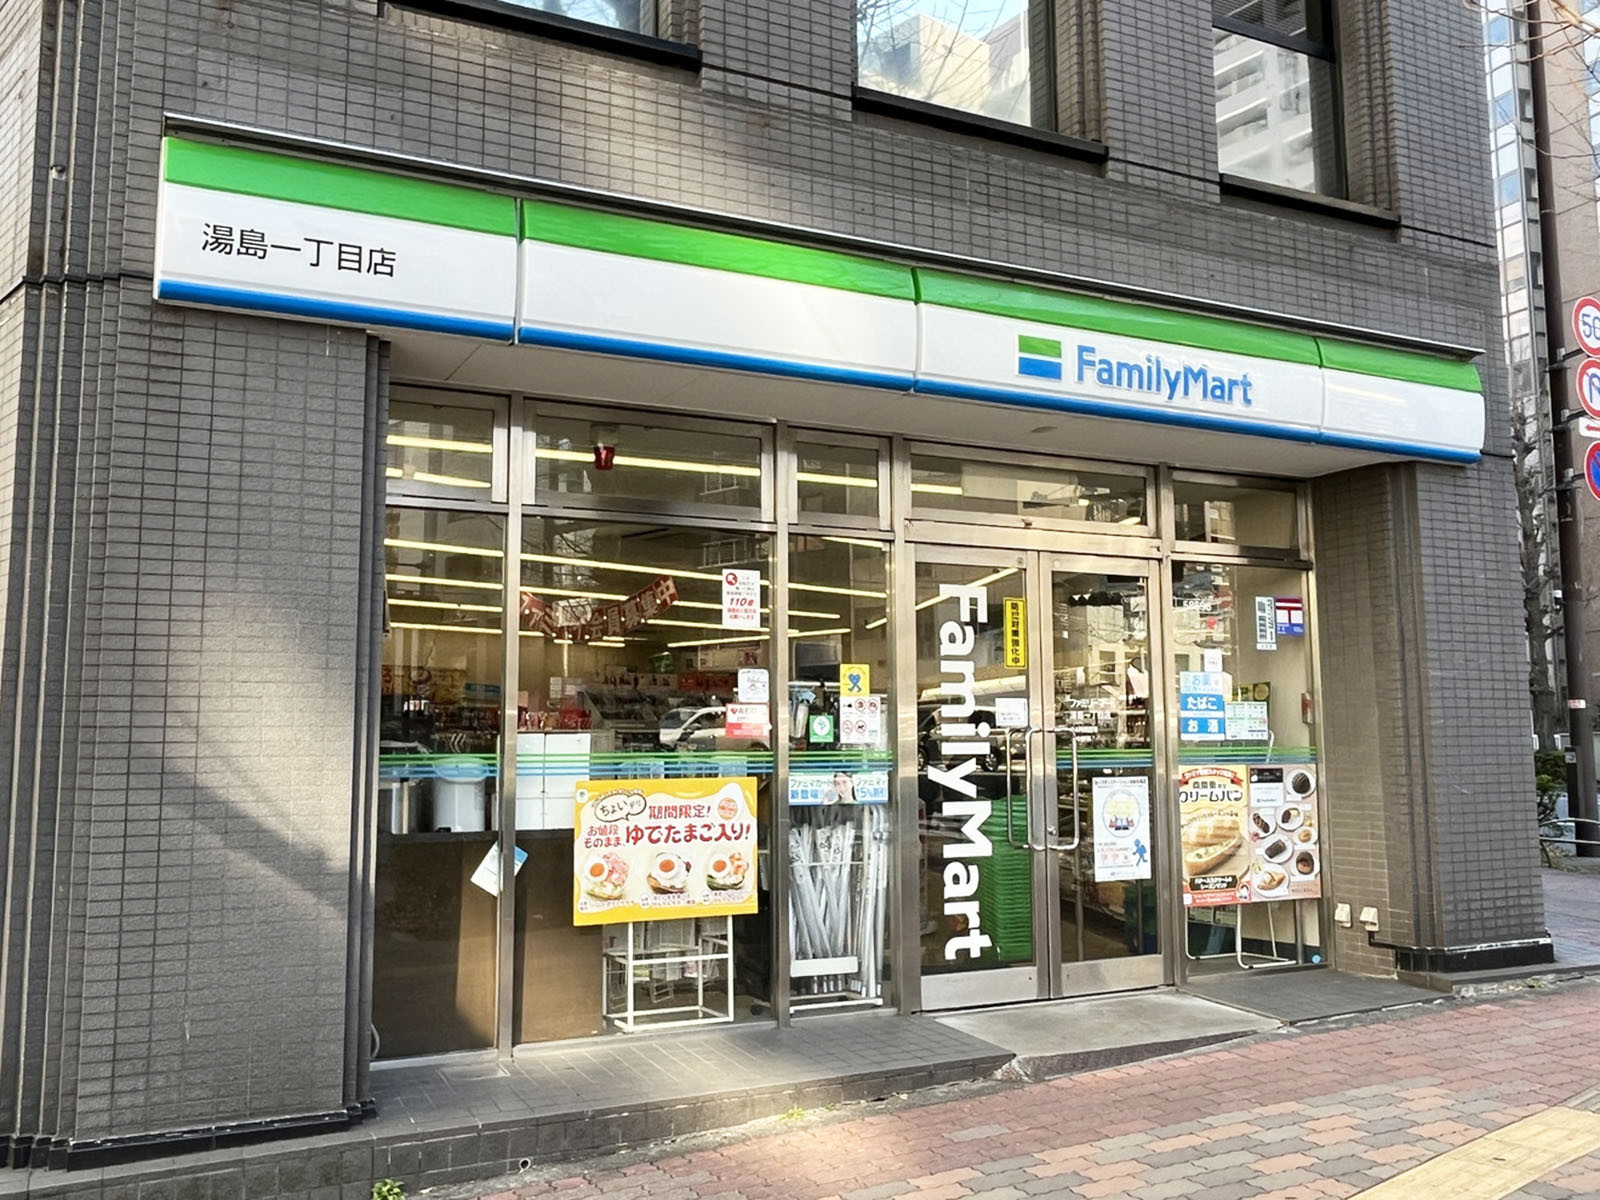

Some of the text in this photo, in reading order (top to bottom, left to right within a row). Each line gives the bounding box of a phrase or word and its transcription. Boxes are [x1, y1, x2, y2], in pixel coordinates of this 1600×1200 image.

[202, 223, 396, 277] 湯島一丁目店
[1077, 344, 1252, 406] FamilyMart
[1186, 695, 1218, 710] たばこ
[927, 583, 993, 961] FamilyMart
[626, 822, 751, 846] ゆでたまご入り!
